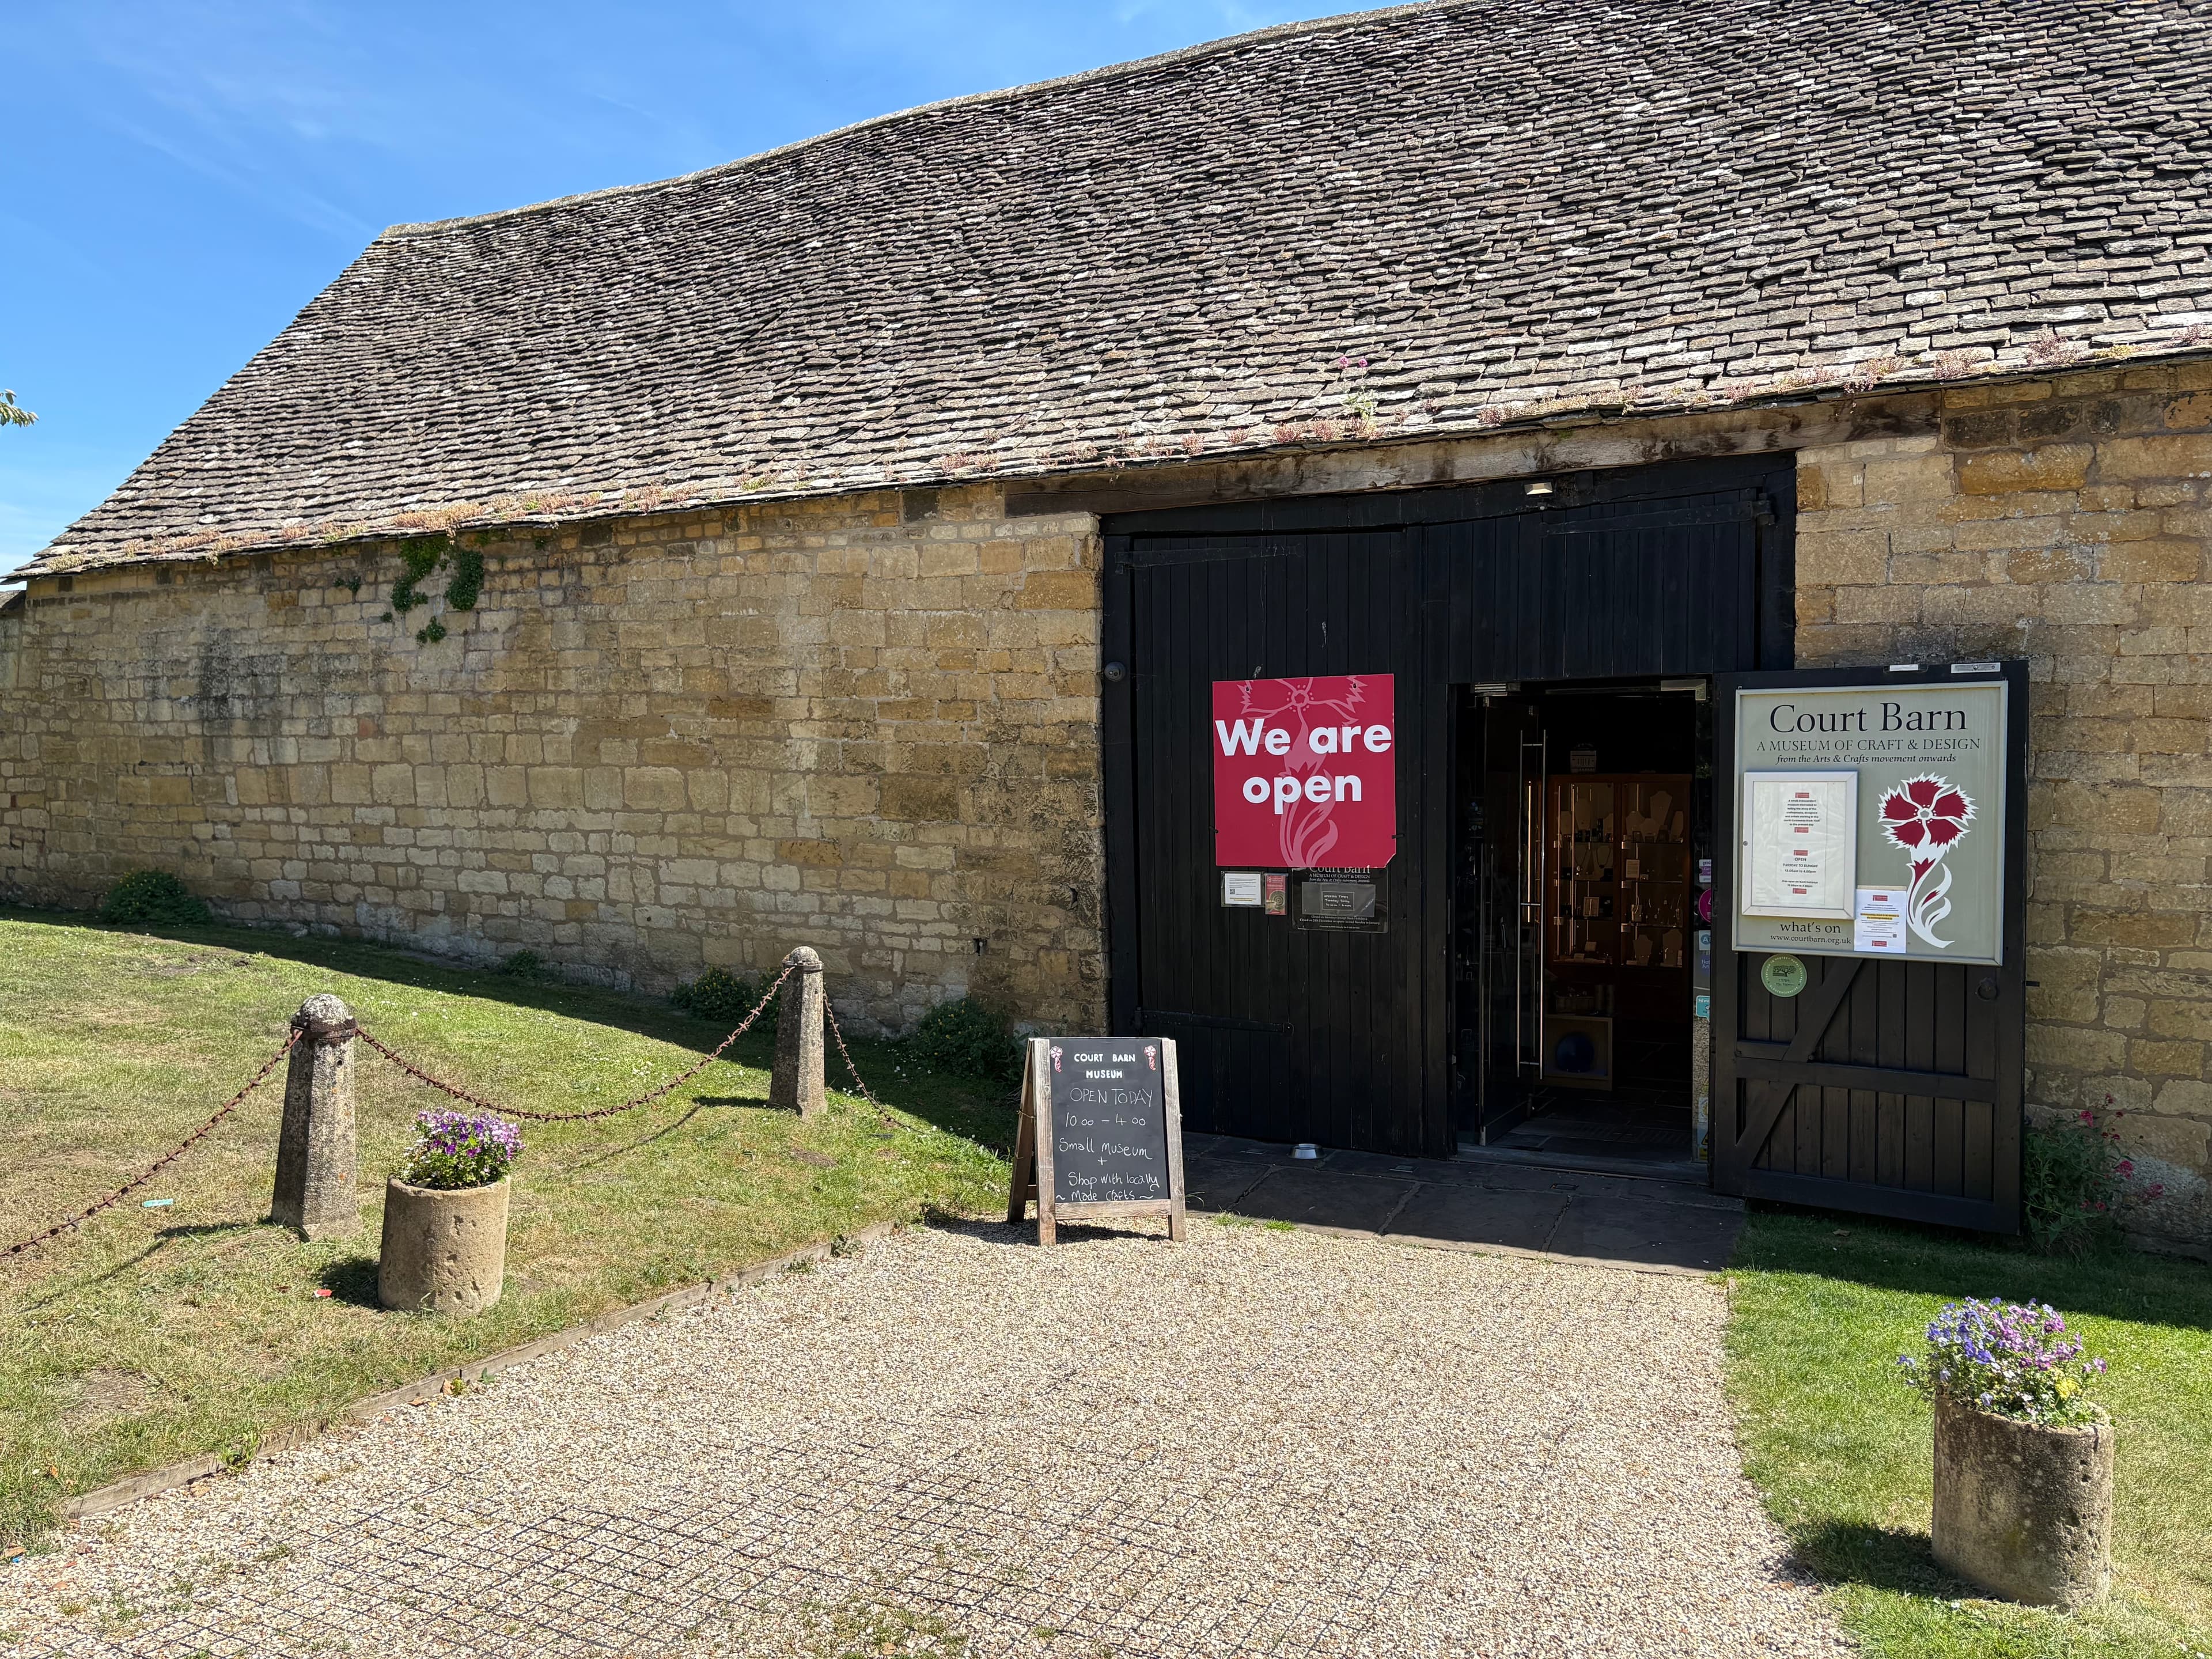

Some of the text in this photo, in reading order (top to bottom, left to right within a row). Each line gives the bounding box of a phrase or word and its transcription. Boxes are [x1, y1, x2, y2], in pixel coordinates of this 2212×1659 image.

[1770, 702, 1968, 733] Court Barn
[1215, 718, 1392, 756] We are
[1757, 738, 1980, 751] A MUSEUM OF CRAFT & DESIGN
[1775, 755, 1796, 765] from
[1798, 755, 1811, 763] the
[1813, 755, 1831, 763] Arts
[1833, 755, 1841, 763] &
[1843, 754, 1869, 764] Crafts
[1918, 753, 1957, 762] onwards
[1243, 775, 1362, 815] open
[1780, 922, 1841, 933] what's on
[1770, 935, 1851, 945] www.courtbarn.org.uk
[1074, 1054, 1135, 1062] COURT BARN
[1086, 1070, 1123, 1078] MUSEUM
[1070, 1088, 1153, 1107] OPEN TODAY
[1059, 1137, 1094, 1152] Small
[1068, 1171, 1097, 1190] Shop
[1126, 1172, 1160, 1192] locally
